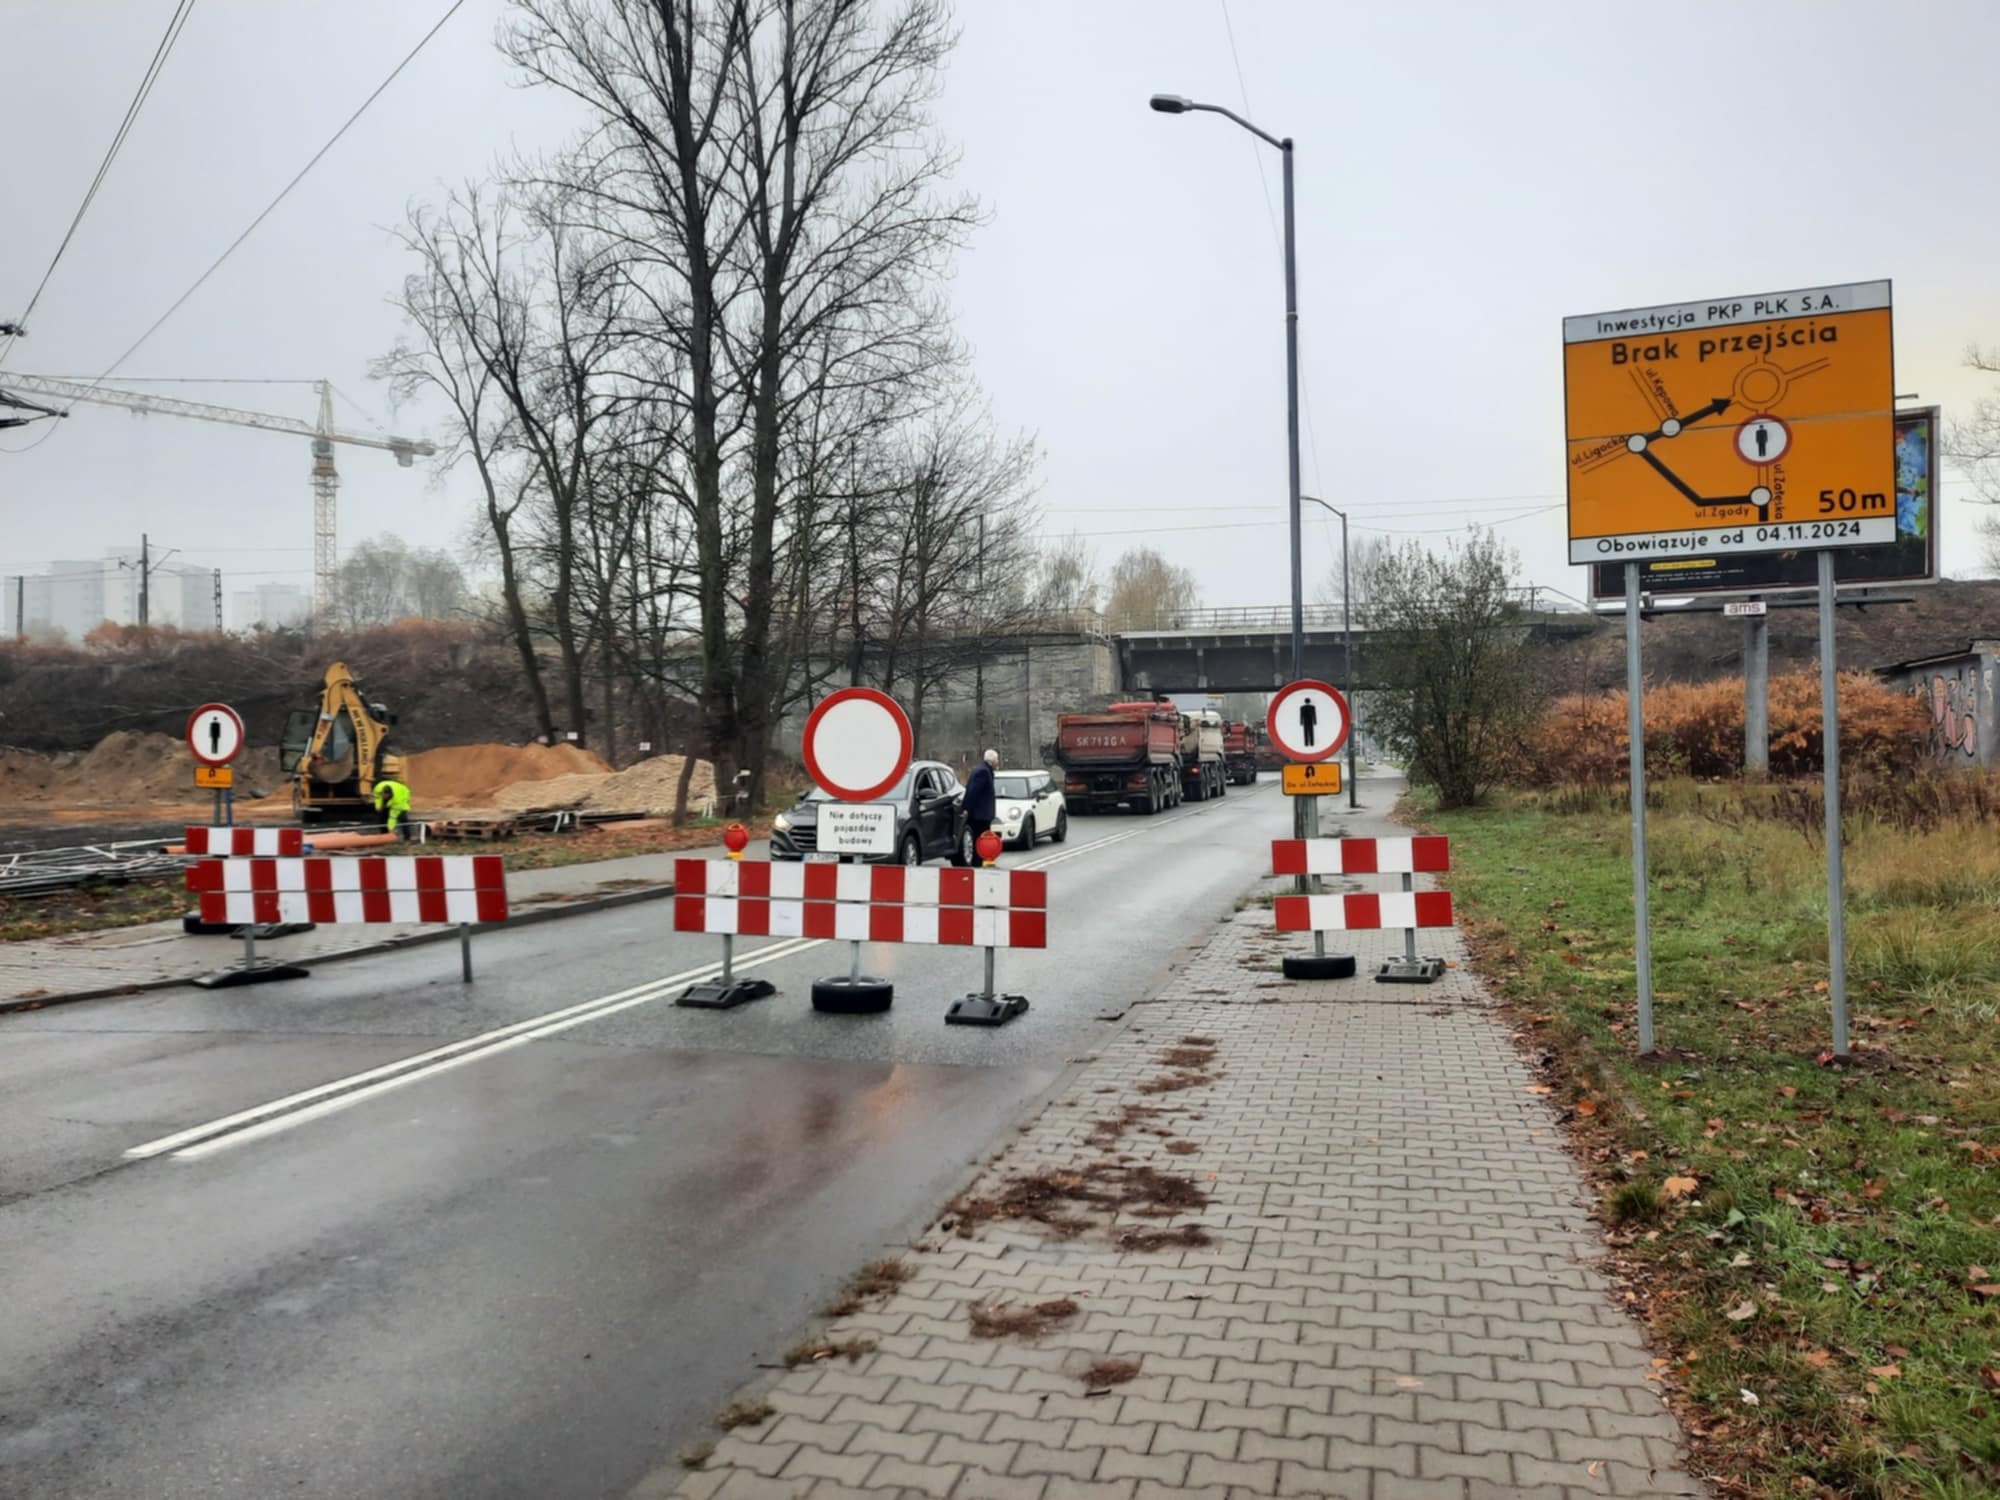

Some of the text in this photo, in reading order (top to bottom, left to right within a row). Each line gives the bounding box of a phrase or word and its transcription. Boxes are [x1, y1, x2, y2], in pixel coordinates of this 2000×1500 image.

[1597, 294, 1840, 333] Inwestycja PKP PLK S.A.
[1611, 321, 1838, 366] Brak przejścia
[1711, 505, 1750, 518] Zgody
[1597, 521, 1861, 553] Obowiązuje od 04.11.2024
[1728, 603, 1762, 614] ams
[829, 810, 882, 822] Nie dotyczy
[833, 824, 876, 834] pojazdów
[838, 836, 872, 847] budowy
